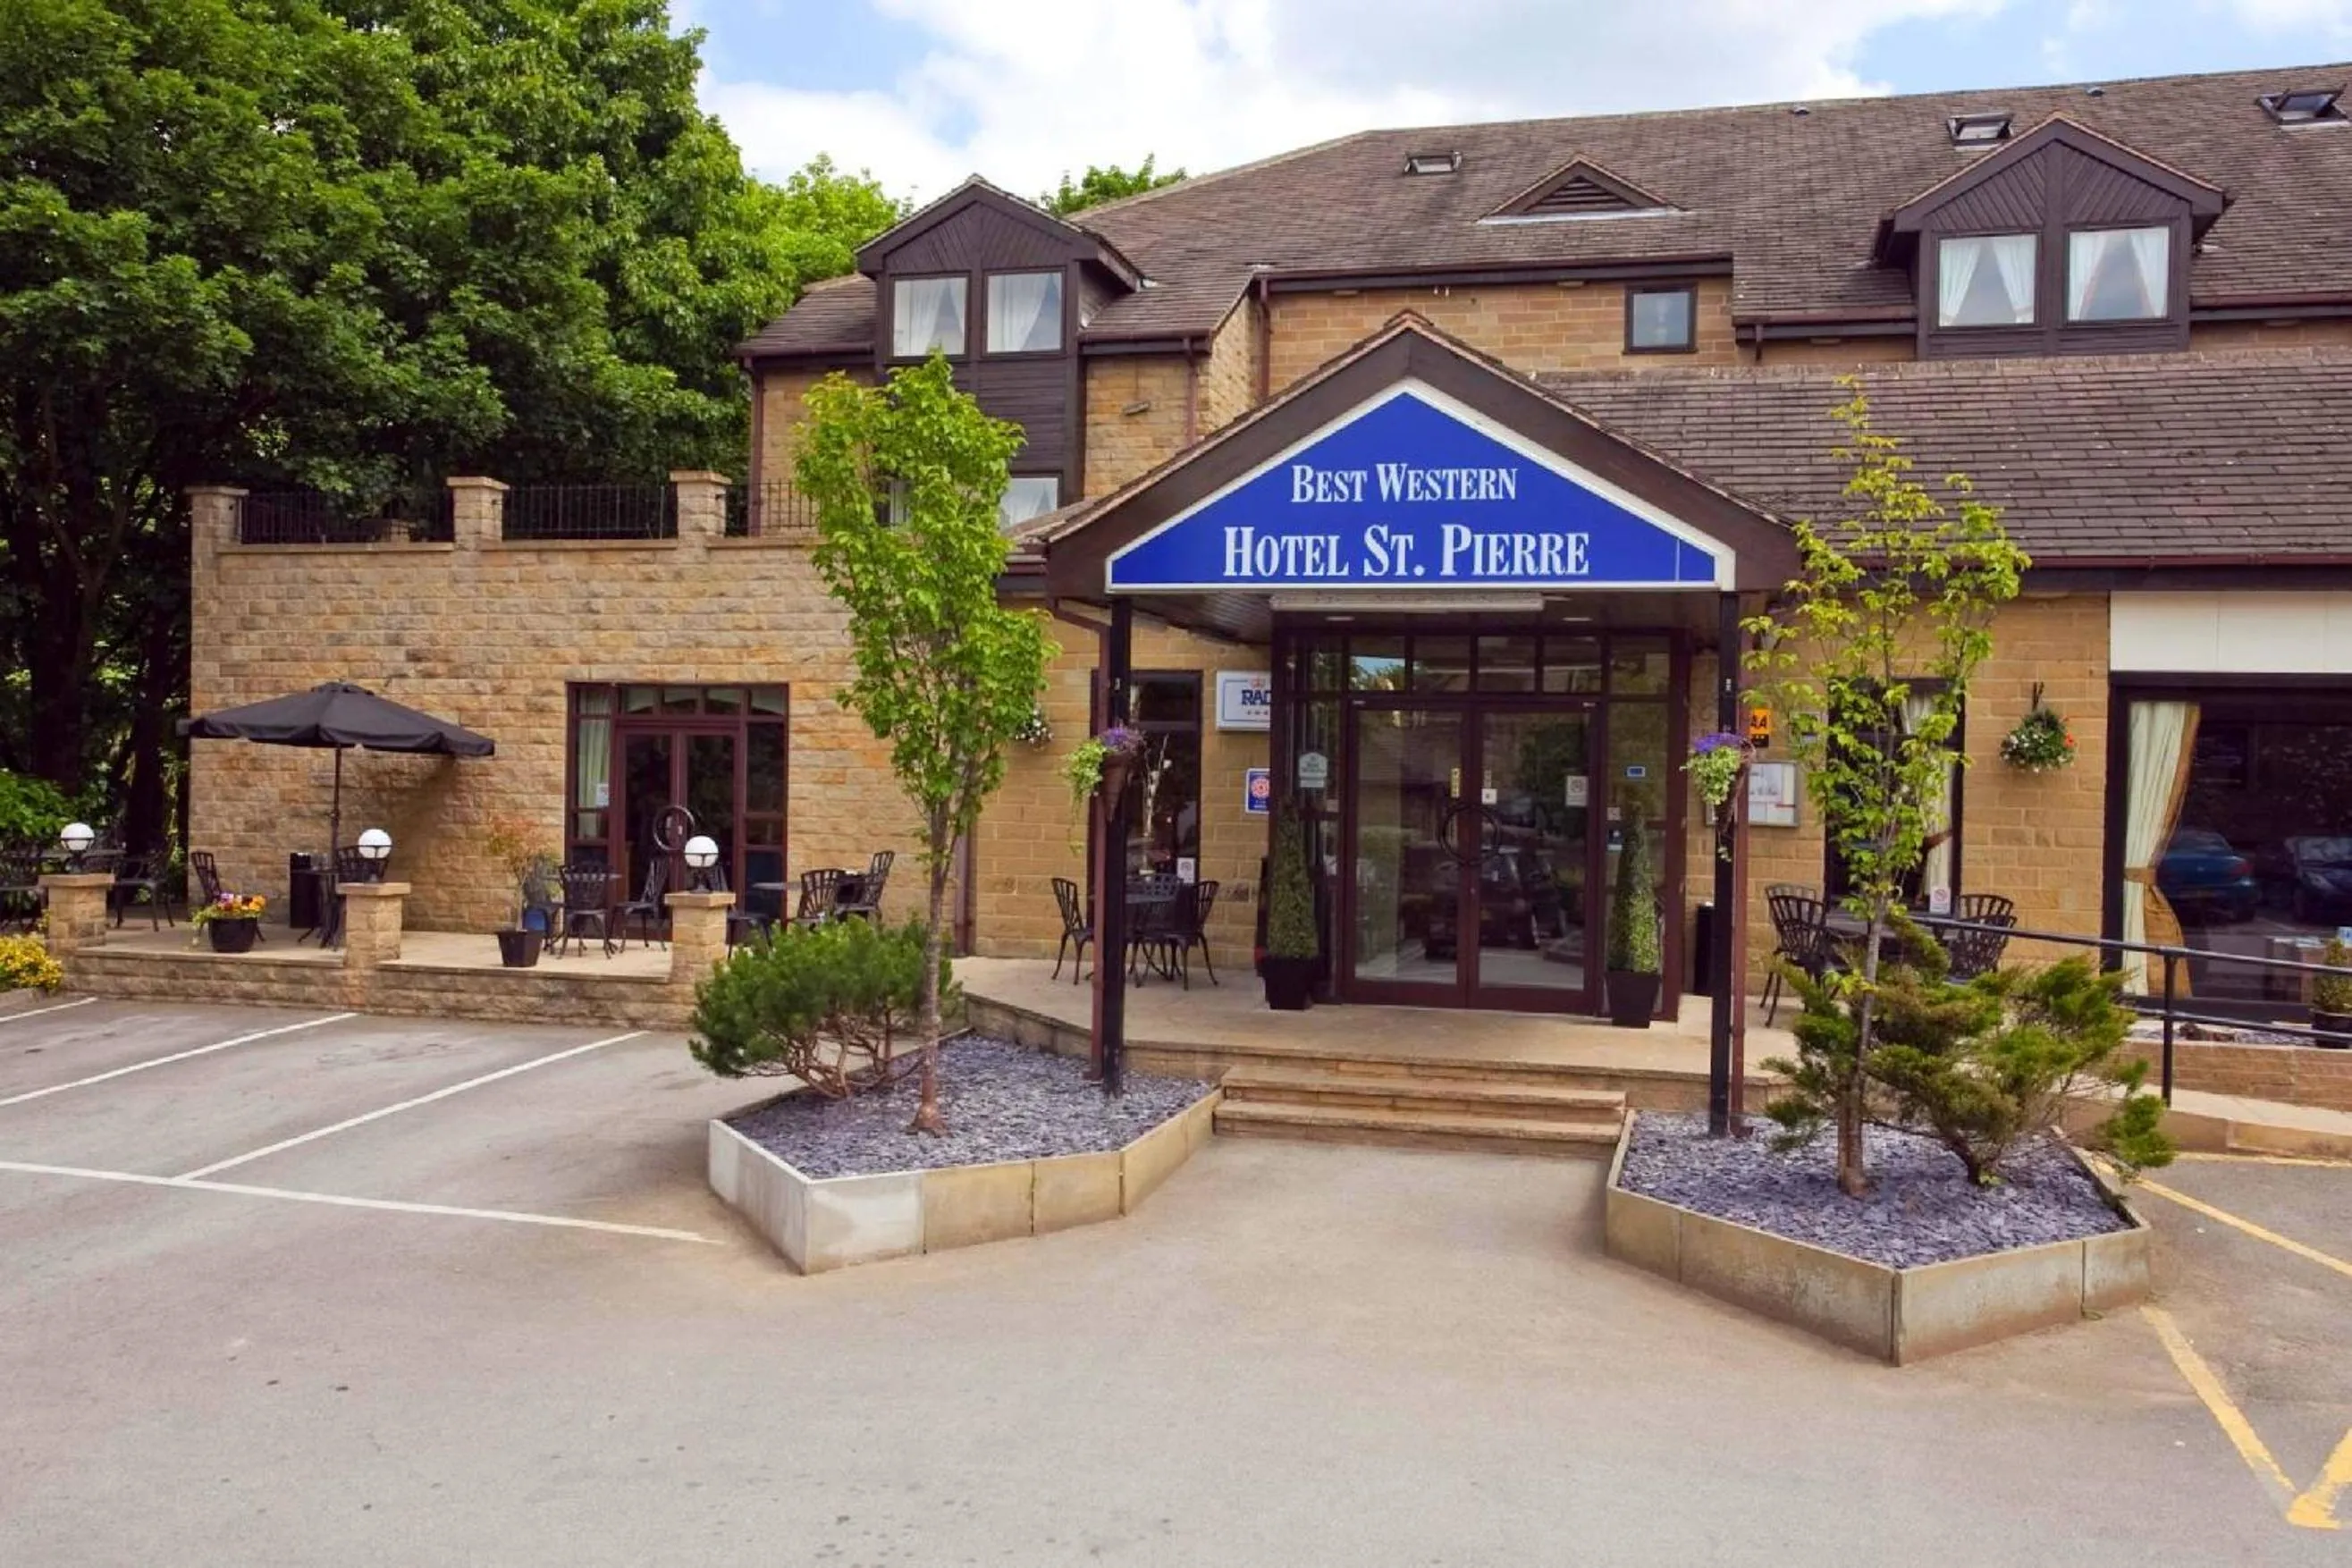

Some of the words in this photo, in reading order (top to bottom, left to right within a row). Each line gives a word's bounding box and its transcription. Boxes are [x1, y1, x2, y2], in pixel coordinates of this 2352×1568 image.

[1291, 464, 1368, 502] BEST
[1376, 463, 1518, 502] WESTERN
[1223, 526, 1349, 577] HOTEL
[1363, 524, 1425, 577] ST.
[1440, 524, 1589, 577] PIERRE
